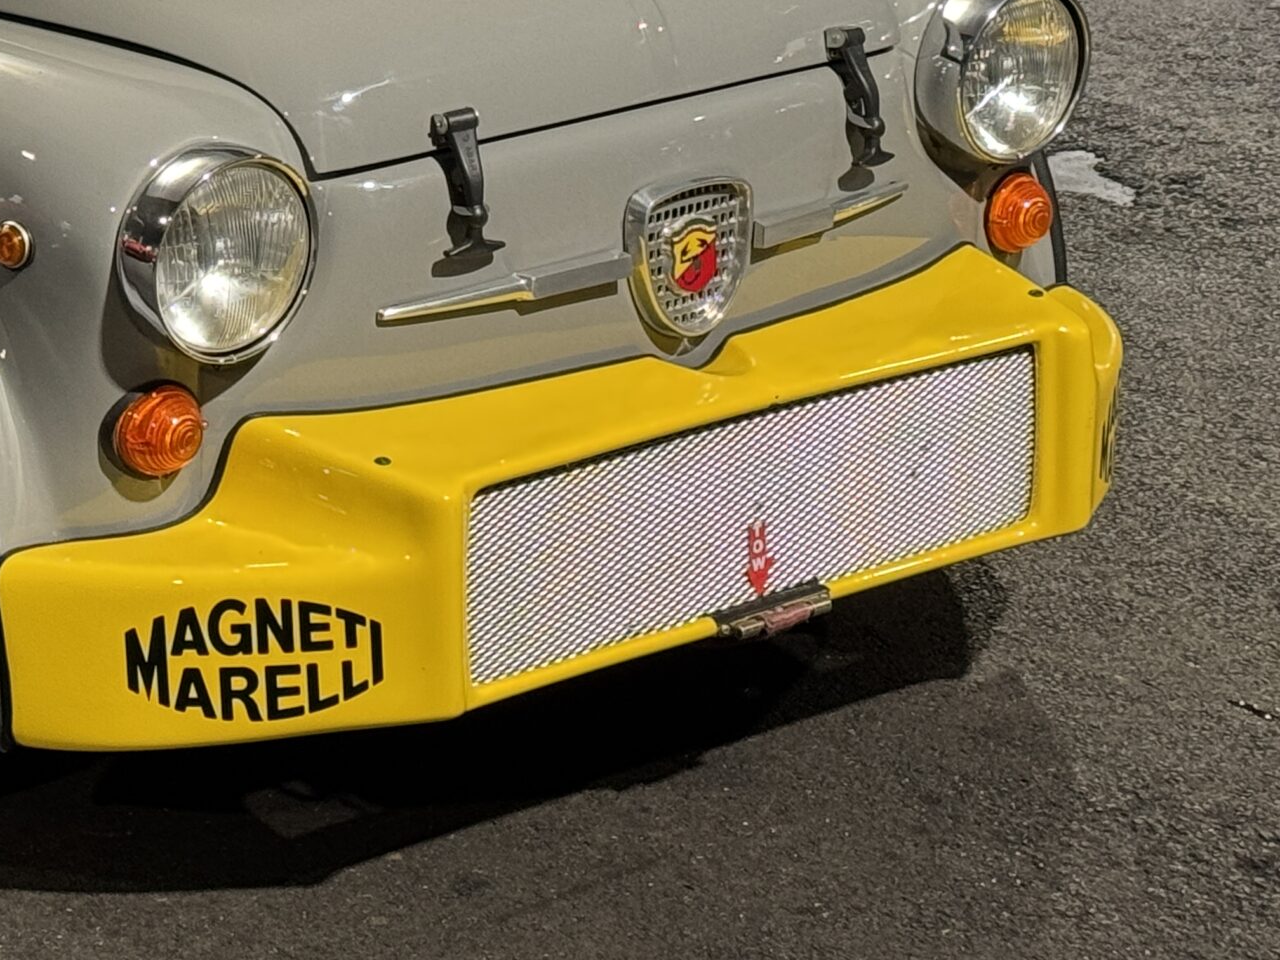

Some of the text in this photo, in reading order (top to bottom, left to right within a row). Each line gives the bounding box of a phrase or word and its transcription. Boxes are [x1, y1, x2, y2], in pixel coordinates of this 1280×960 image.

[752, 520, 766, 572] TOW
[125, 597, 384, 708] MAGNETI
[125, 615, 384, 722] MARELLI
